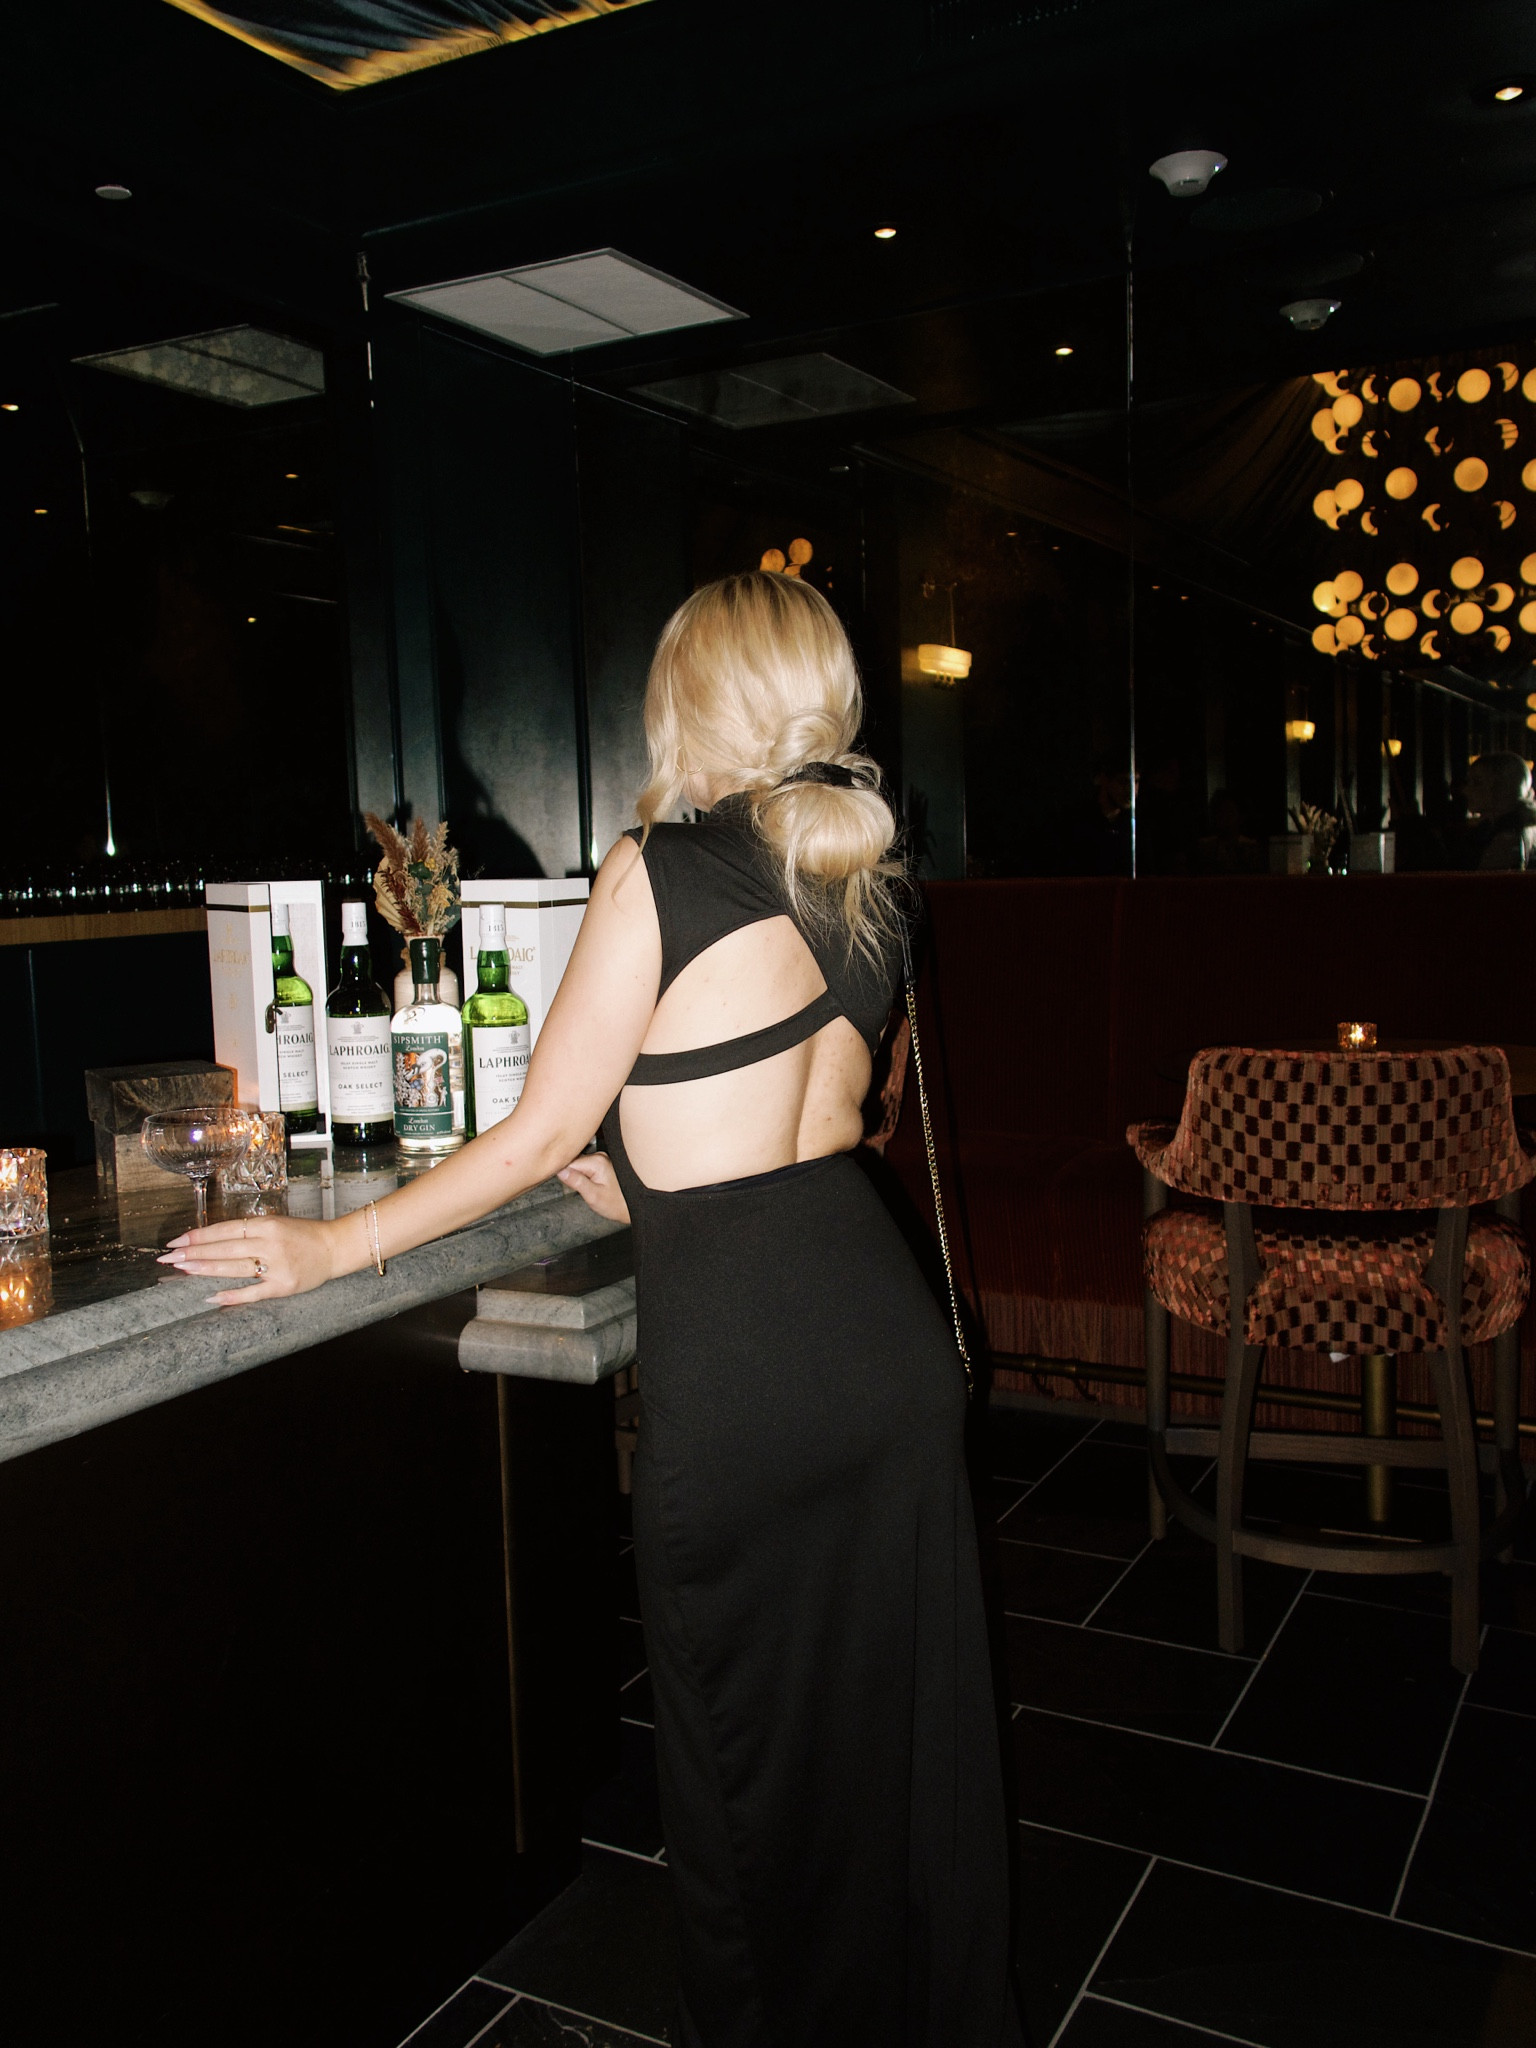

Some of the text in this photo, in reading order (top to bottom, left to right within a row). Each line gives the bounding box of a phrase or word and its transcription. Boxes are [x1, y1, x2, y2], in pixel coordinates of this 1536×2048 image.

[470, 946, 534, 962] LOAIG
[393, 1035, 442, 1045] SIPSMITH
[329, 1042, 391, 1057] LAPHROAIG
[479, 1054, 531, 1069] LAPHROA
[283, 1070, 309, 1078] SELECT
[355, 1081, 383, 1090] SELECT
[403, 1124, 418, 1132] DRY
[419, 1123, 436, 1132] GIN
